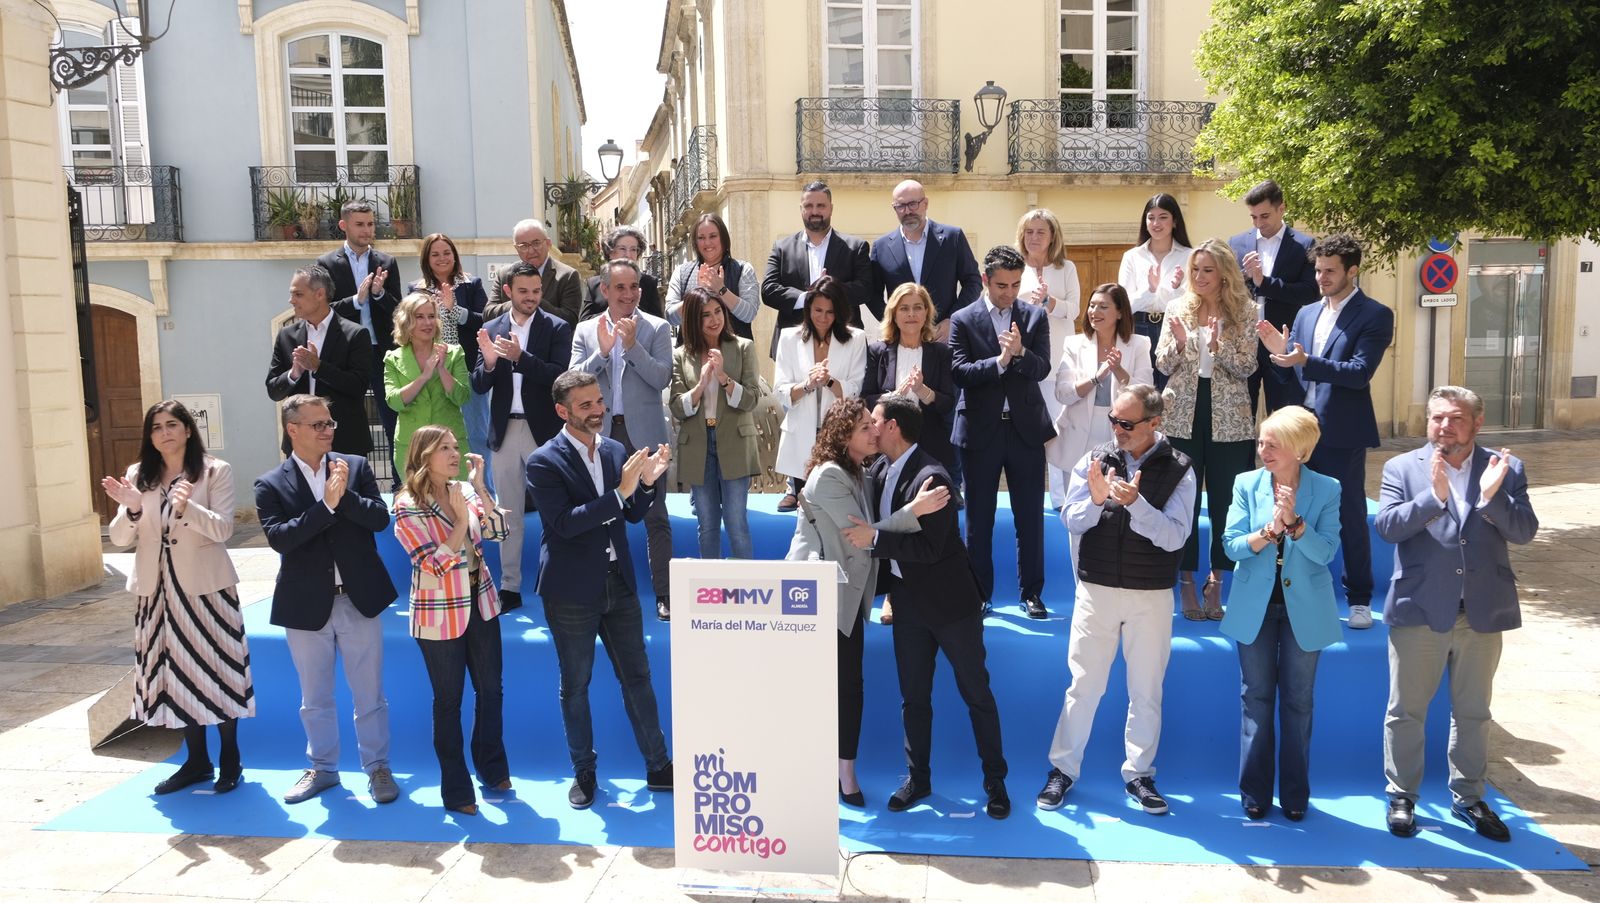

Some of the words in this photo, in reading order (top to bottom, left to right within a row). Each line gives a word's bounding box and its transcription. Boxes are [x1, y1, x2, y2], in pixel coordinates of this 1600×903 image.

[1585, 262, 1591, 271] 7
[691, 619, 723, 631] María
[725, 620, 743, 631] del
[744, 621, 768, 632] Mar
[769, 620, 817, 633] Vázquez
[694, 747, 725, 772] mi
[693, 771, 757, 793] COM
[694, 792, 751, 815] PRO
[694, 814, 764, 837] MISO
[693, 832, 787, 859] contigo
